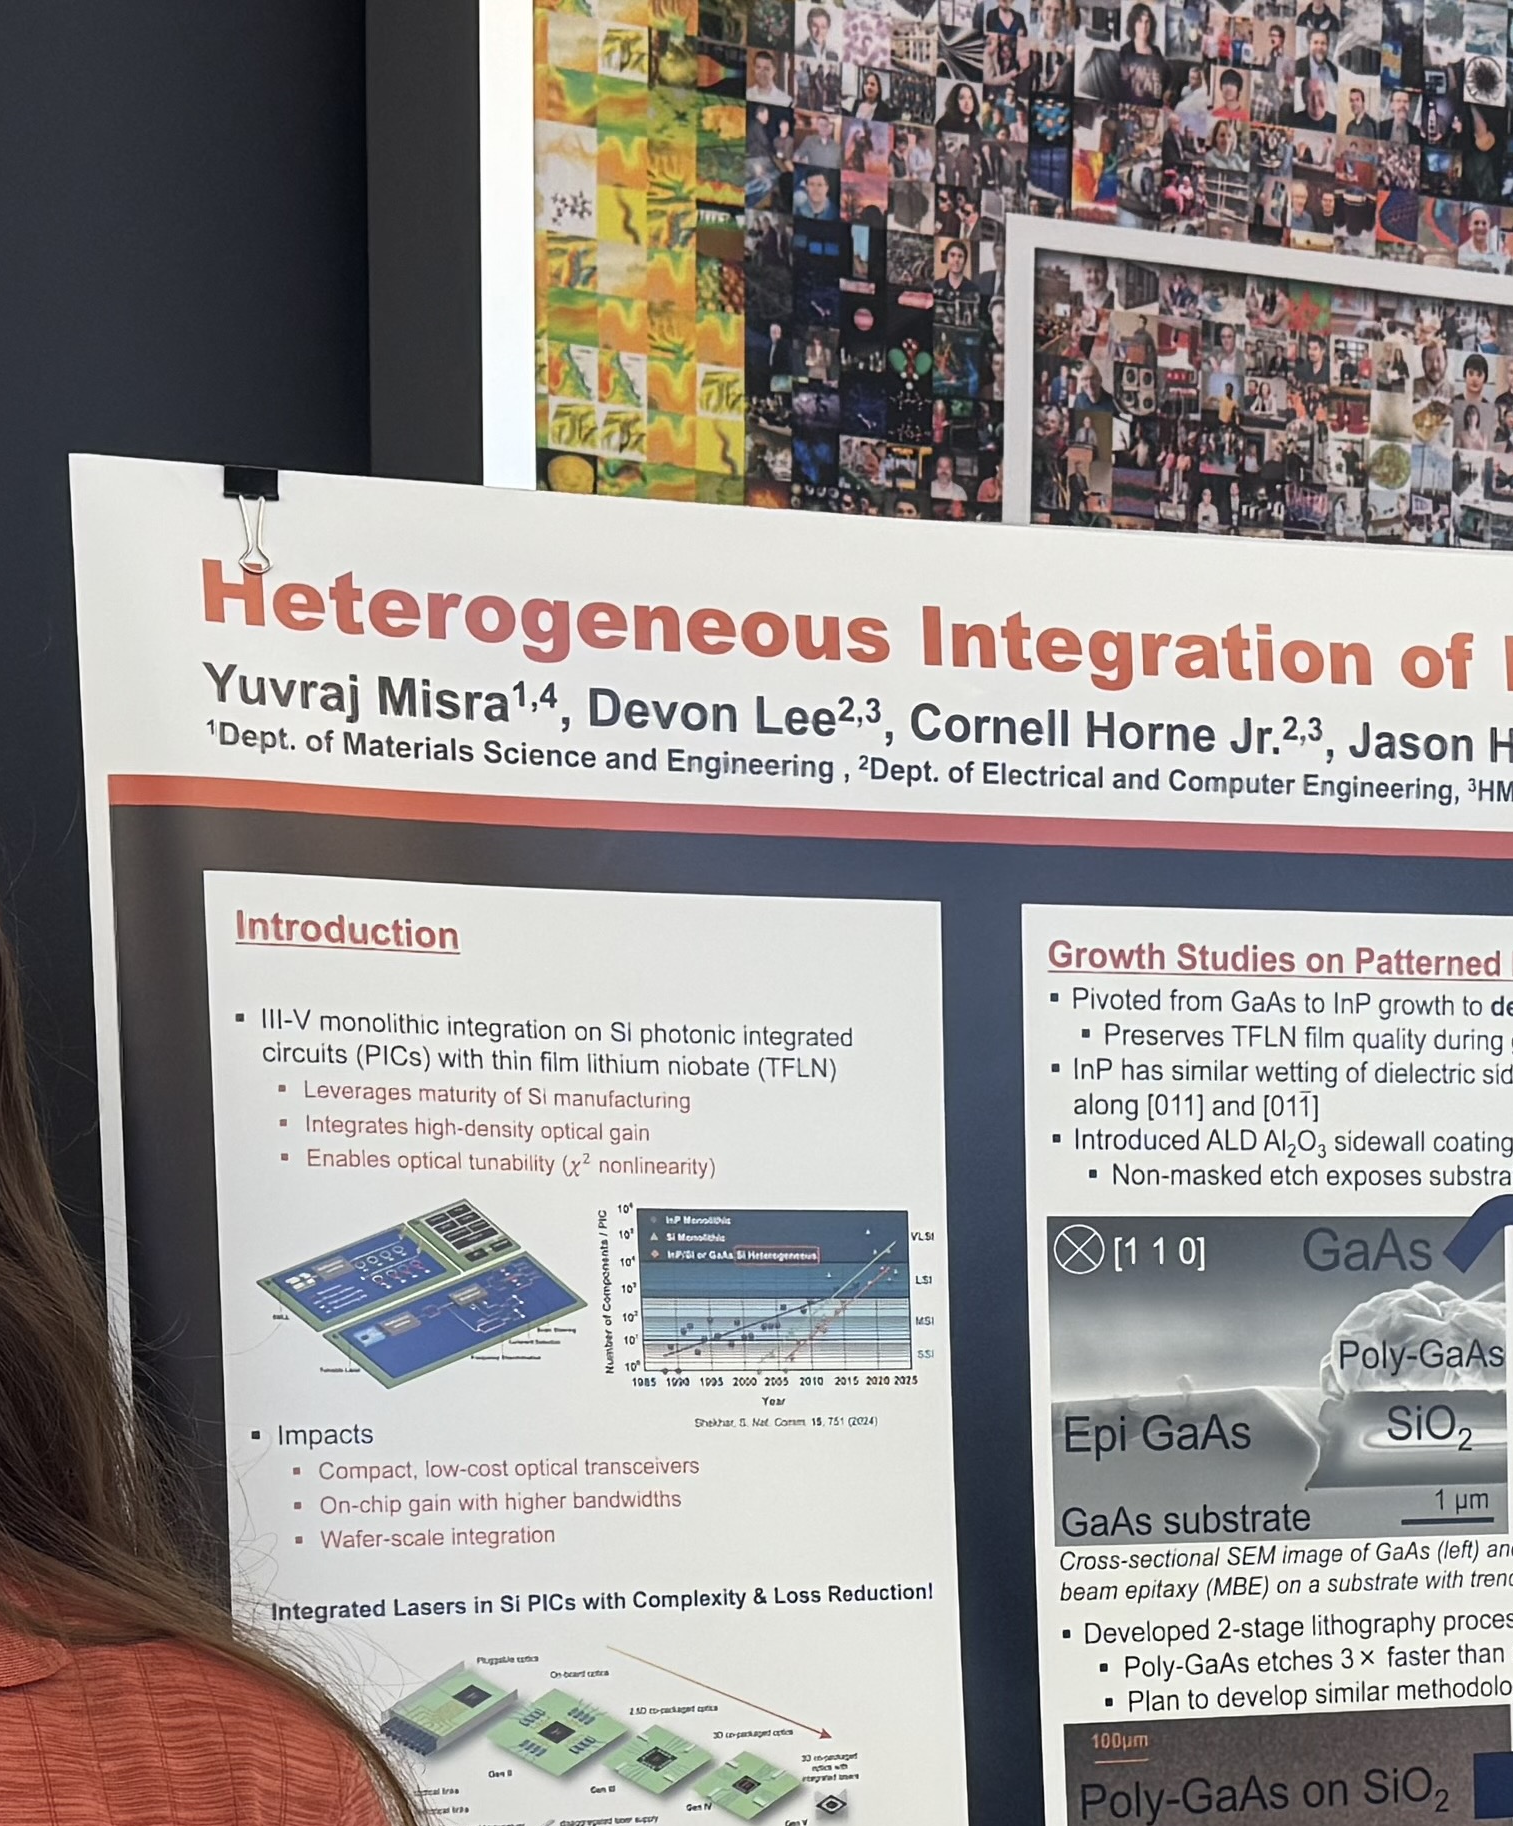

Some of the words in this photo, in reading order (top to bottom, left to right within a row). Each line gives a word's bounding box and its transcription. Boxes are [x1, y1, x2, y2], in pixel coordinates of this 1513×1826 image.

[201, 557, 891, 665] Heterogeneous
[922, 605, 1373, 692] Integration
[1400, 631, 1474, 690] of
[202, 660, 360, 725] Yuvraj
[589, 686, 737, 734] Devon
[910, 701, 1069, 748] Cornell
[1086, 709, 1216, 753] Horne
[1348, 721, 1474, 763] Jason
[236, 908, 459, 950] Introduction
[1048, 939, 1166, 971] Growth
[1177, 941, 1296, 973] Studies
[1306, 952, 1344, 975] on
[1355, 945, 1501, 978] Patterned
[262, 1007, 311, 1032] III-V
[319, 1011, 440, 1037] monolithic
[447, 1014, 566, 1044] integration
[574, 1024, 602, 1043] on
[610, 1020, 632, 1043] Si
[640, 1021, 736, 1050] photonic
[743, 1024, 853, 1052] integrated
[1104, 1021, 1225, 1048] Preserves
[1231, 1023, 1296, 1049] TFLN
[1304, 1024, 1344, 1050] film
[1352, 1026, 1427, 1056] quality
[1433, 1027, 1504, 1057] during
[304, 1078, 412, 1106] Leverages
[418, 1085, 497, 1109] maturity
[503, 1085, 523, 1106] of
[528, 1086, 547, 1106] Si
[553, 1088, 691, 1115] manufacturing
[1302, 1226, 1434, 1272] GaAs
[1338, 1337, 1506, 1372] Poly-GaAs
[278, 1423, 374, 1451] Impacts
[1064, 1417, 1133, 1460] Epi
[1142, 1414, 1253, 1453] GaAs
[320, 1528, 445, 1550] Wafer-scale
[451, 1526, 555, 1550] integration
[1060, 1507, 1155, 1538] GaAs
[1164, 1502, 1311, 1536] substrate
[271, 1598, 386, 1625] Integrated
[393, 1598, 467, 1618] Lasers
[474, 1595, 493, 1615] in
[500, 1593, 520, 1614] Si
[528, 1592, 576, 1614] PICs
[582, 1591, 626, 1611] with
[632, 1587, 747, 1613] Complexity
[753, 1587, 768, 1606] &
[773, 1586, 822, 1605] Loss
[827, 1581, 933, 1604] Reduction!
[1128, 1688, 1180, 1714] Plan
[1187, 1688, 1209, 1711] to
[1216, 1683, 1308, 1711] develop
[1315, 1680, 1390, 1705] similar
